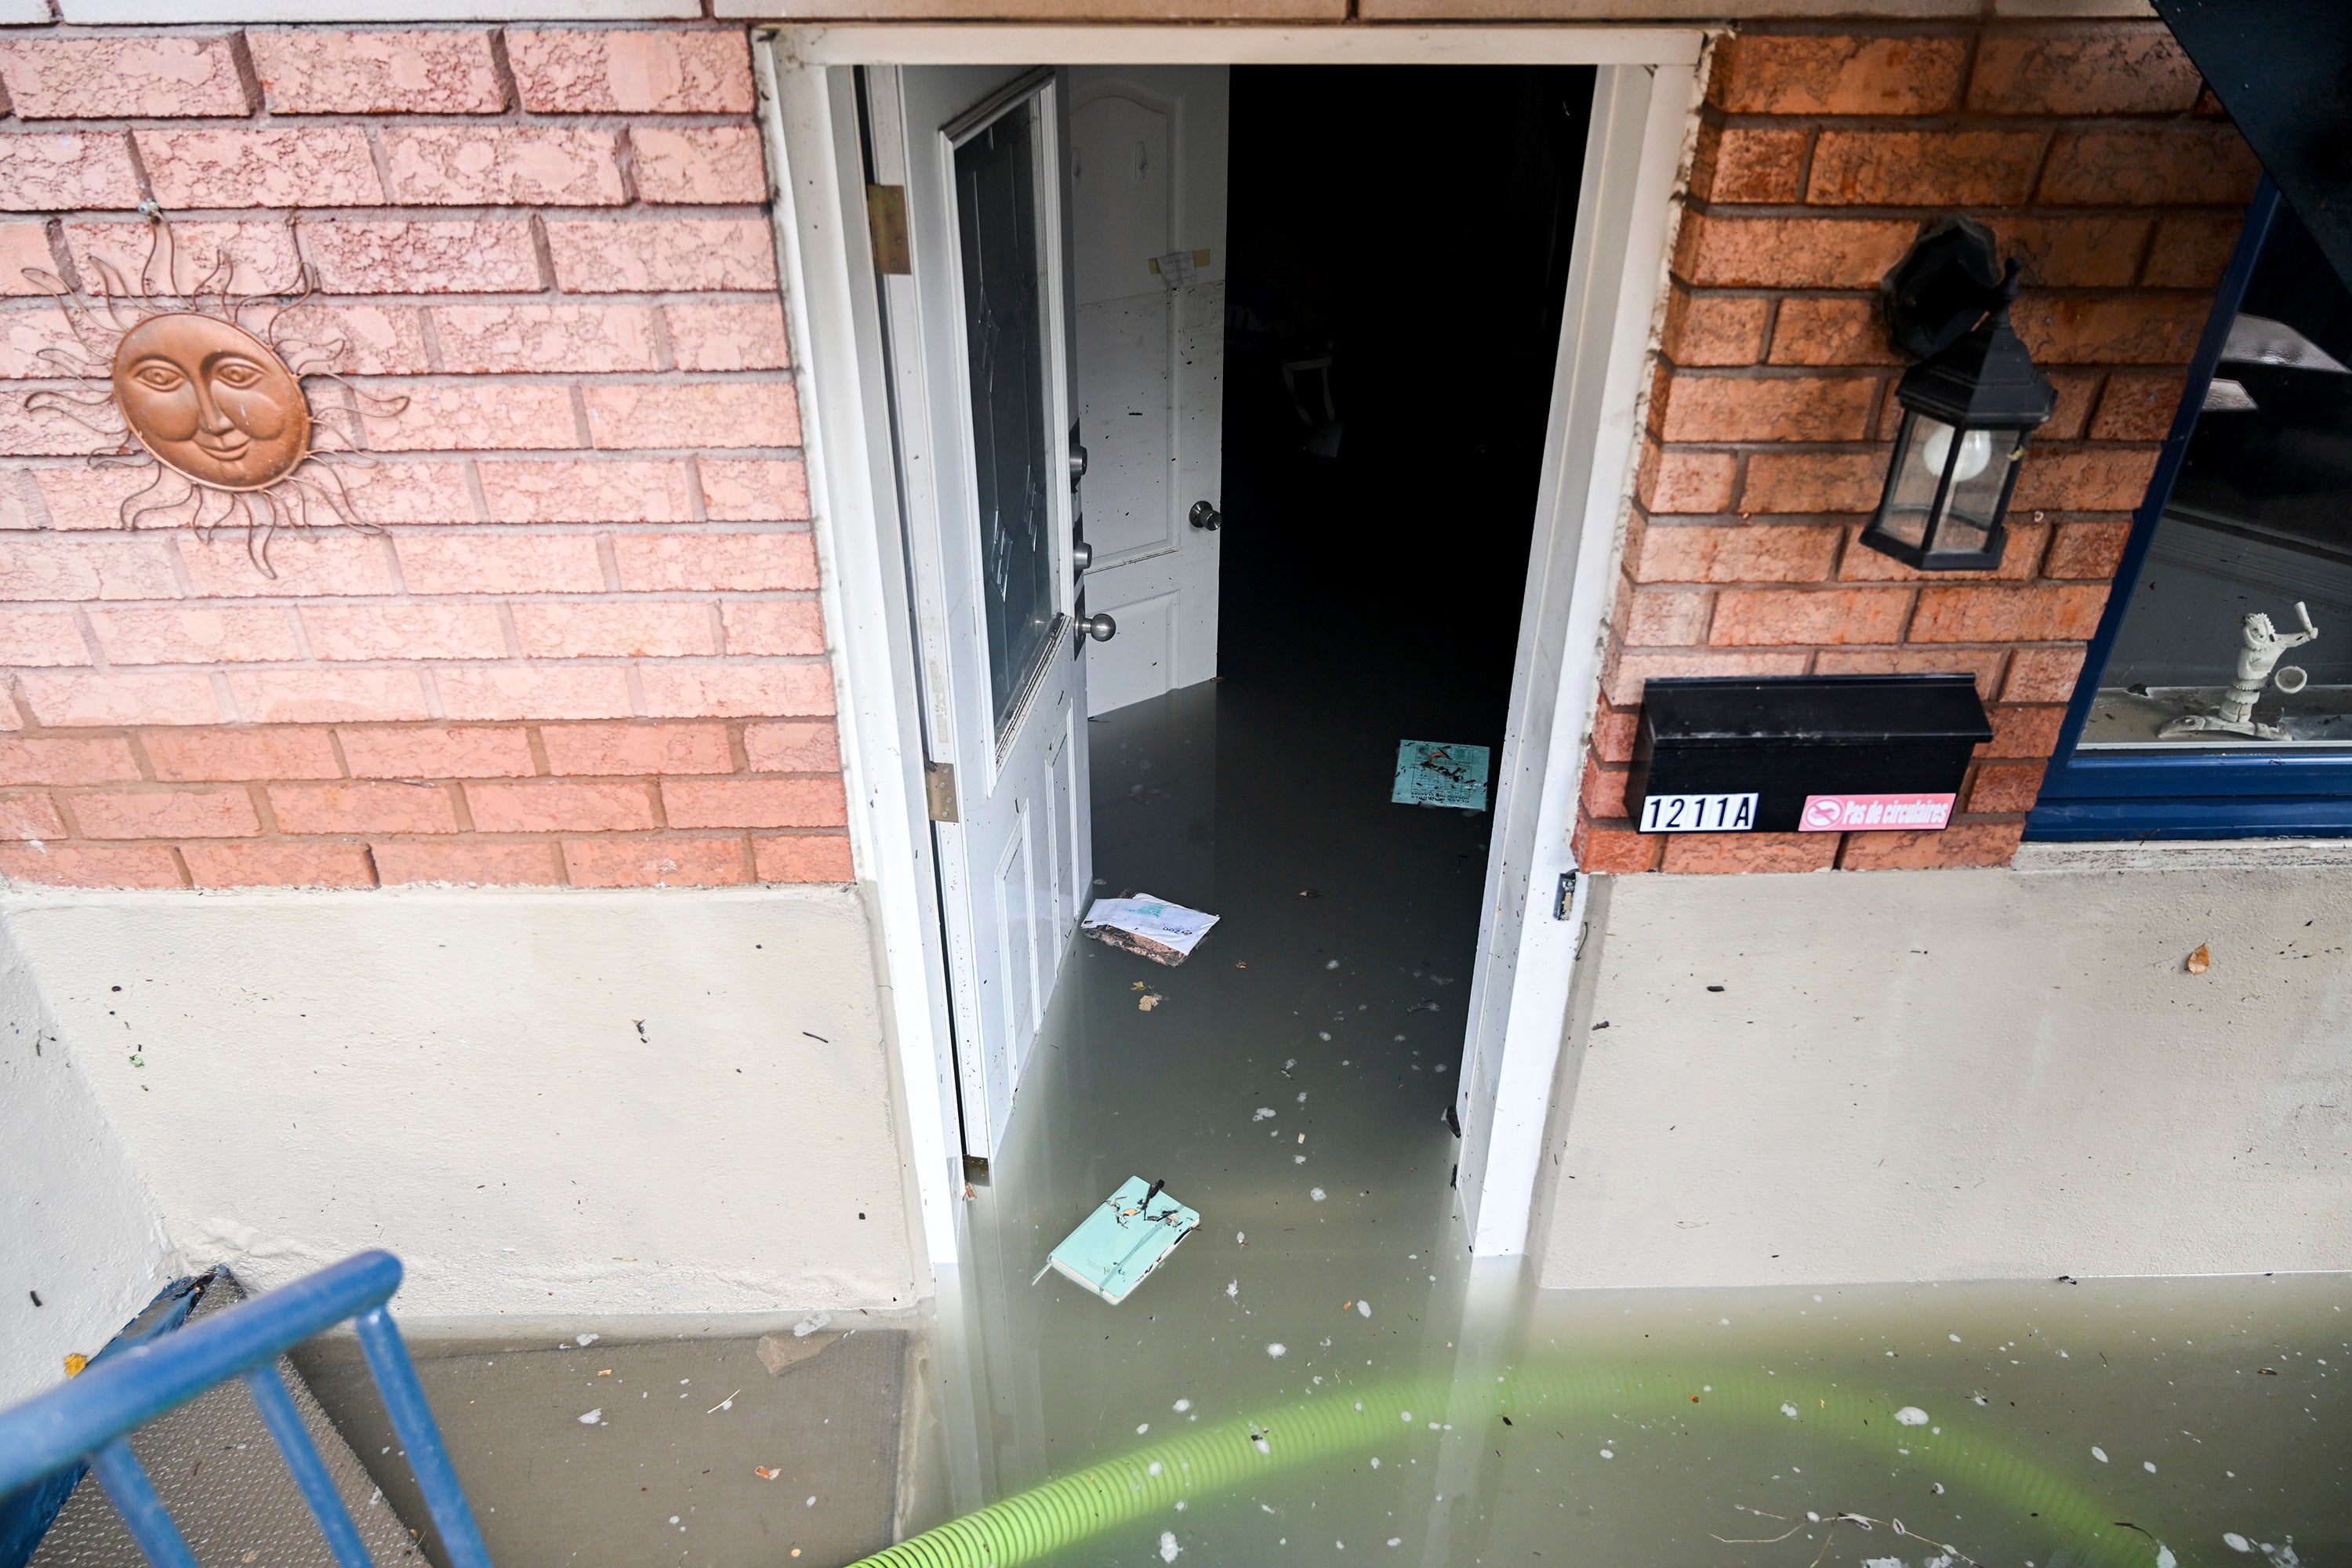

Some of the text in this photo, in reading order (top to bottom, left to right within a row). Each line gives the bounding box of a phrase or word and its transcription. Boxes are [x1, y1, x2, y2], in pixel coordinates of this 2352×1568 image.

[1650, 797, 1750, 828] 1211A
[1842, 799, 1949, 825] Pas de circulaires
